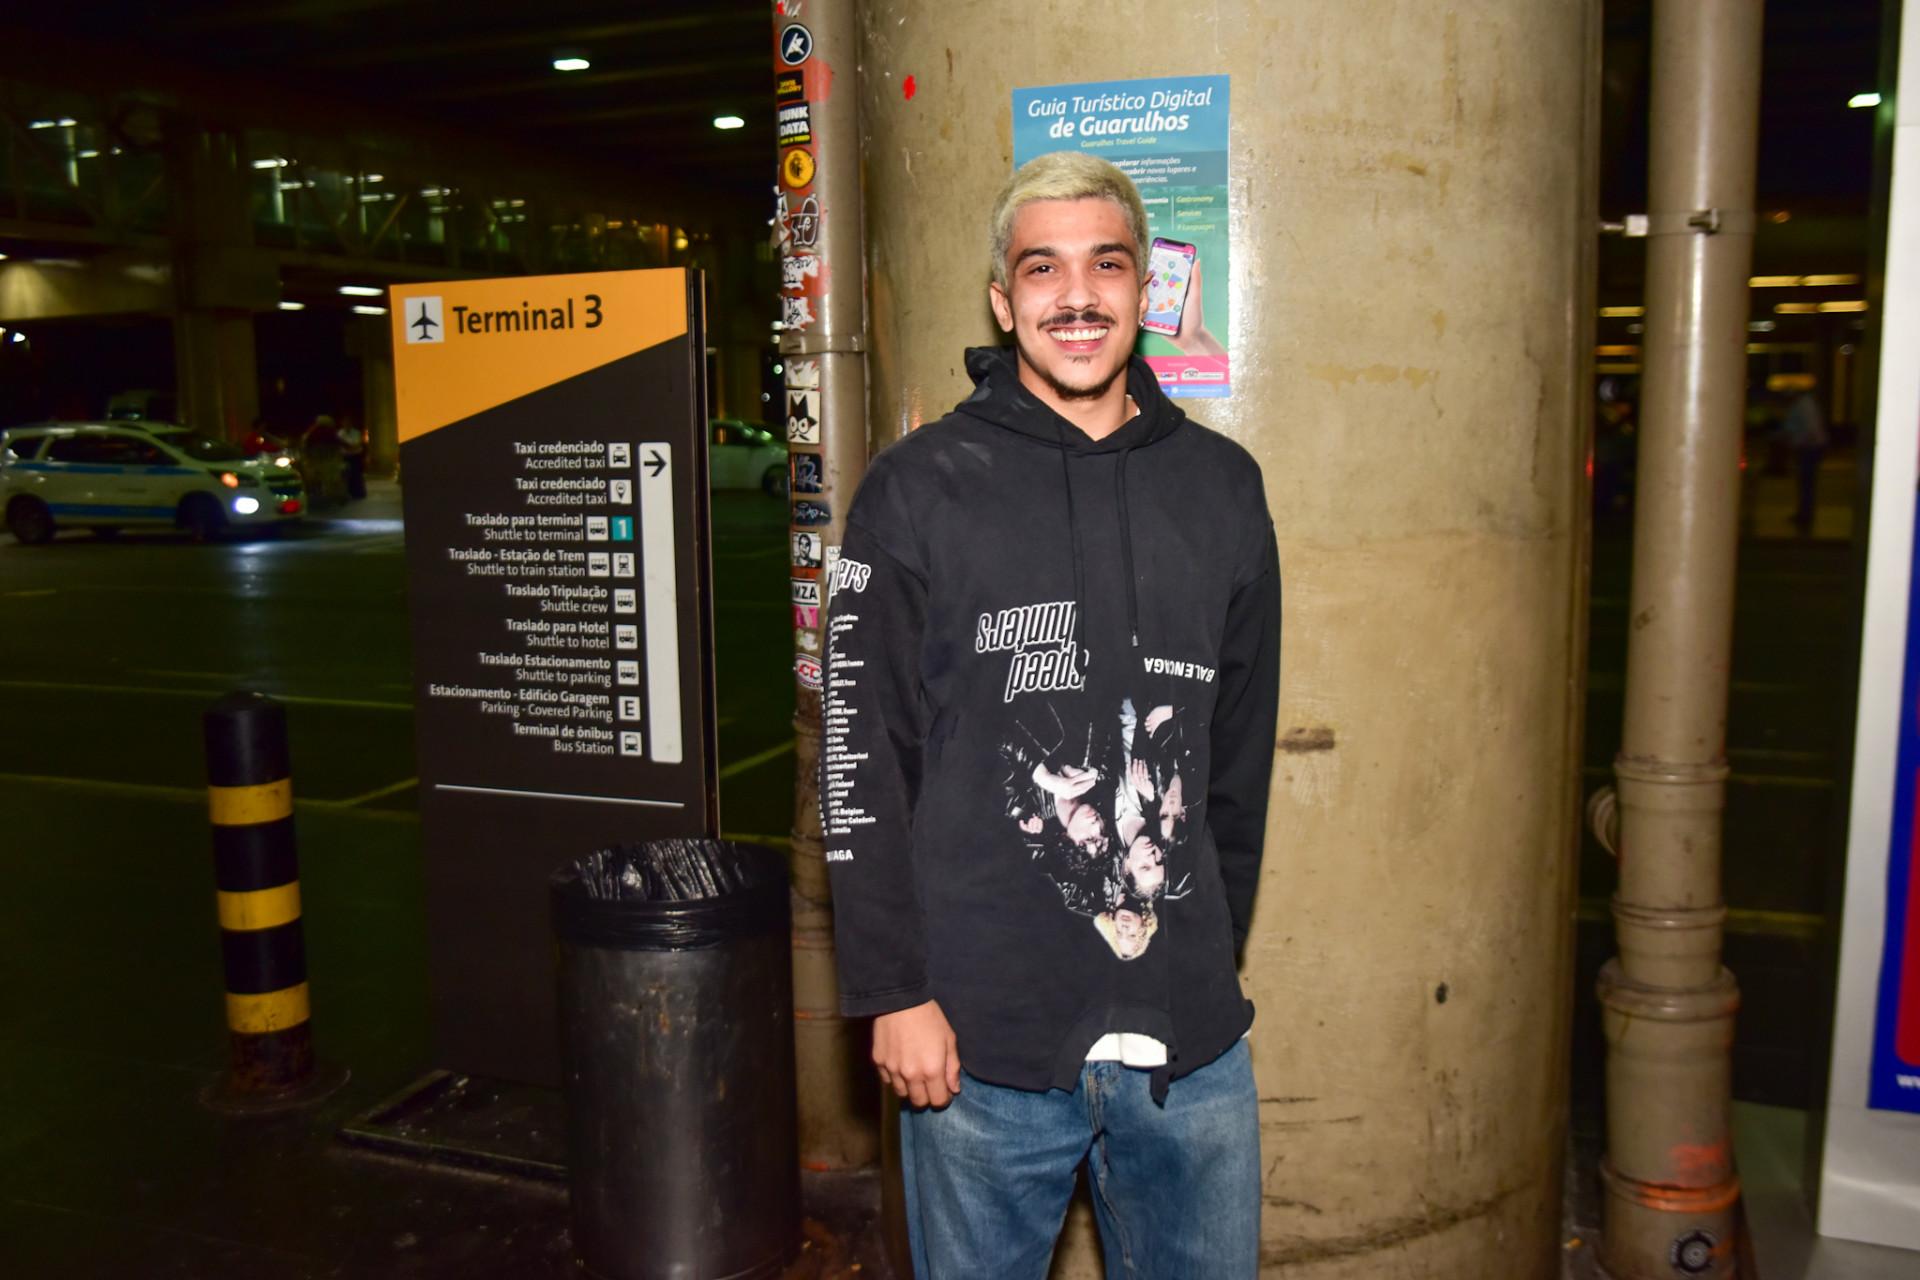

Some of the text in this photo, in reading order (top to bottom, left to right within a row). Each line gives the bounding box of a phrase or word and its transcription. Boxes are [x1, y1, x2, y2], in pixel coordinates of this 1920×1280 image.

[1028, 87, 1212, 118] Guia Turístico Digital
[780, 121, 809, 136] DATA
[1050, 111, 1189, 139] de Guarulhos
[1116, 137, 1136, 145] Travel
[1137, 136, 1157, 144] Guide
[1167, 166, 1190, 174] lugares
[453, 294, 603, 334] Terminal 3
[514, 442, 604, 454] Taxi credenciado
[526, 456, 606, 469] Accredited taxi
[516, 478, 606, 490] Taxi credenciado
[527, 492, 607, 505] Accredited taxi
[466, 513, 583, 528] Traslado para terminal
[484, 528, 584, 541] Shuttle to terminal
[618, 520, 627, 538] 1
[449, 548, 492, 561] Traslado
[500, 549, 541, 563] Estação
[542, 549, 556, 561] de
[558, 550, 585, 562] Trem
[468, 562, 585, 577] Shuttle to train station
[506, 584, 608, 600] Traslado Tripulação
[541, 600, 608, 613] Shuttle crew
[506, 619, 609, 636] Traslado para Hotel
[975, 601, 1076, 653] hunters
[527, 634, 610, 648] Shuttle to hotel
[480, 652, 611, 669] Traslado Estacionamento
[516, 668, 612, 687] Shuttle to parking
[430, 684, 512, 700] Estacionamento
[520, 688, 558, 702] Edifício
[560, 691, 610, 706] Garagem
[482, 702, 520, 717] Parking
[528, 704, 570, 717] Covered
[572, 706, 613, 722] Parking
[624, 701, 635, 716] E
[513, 723, 614, 740] Terminal de ônibus
[554, 740, 614, 755] Bus Station
